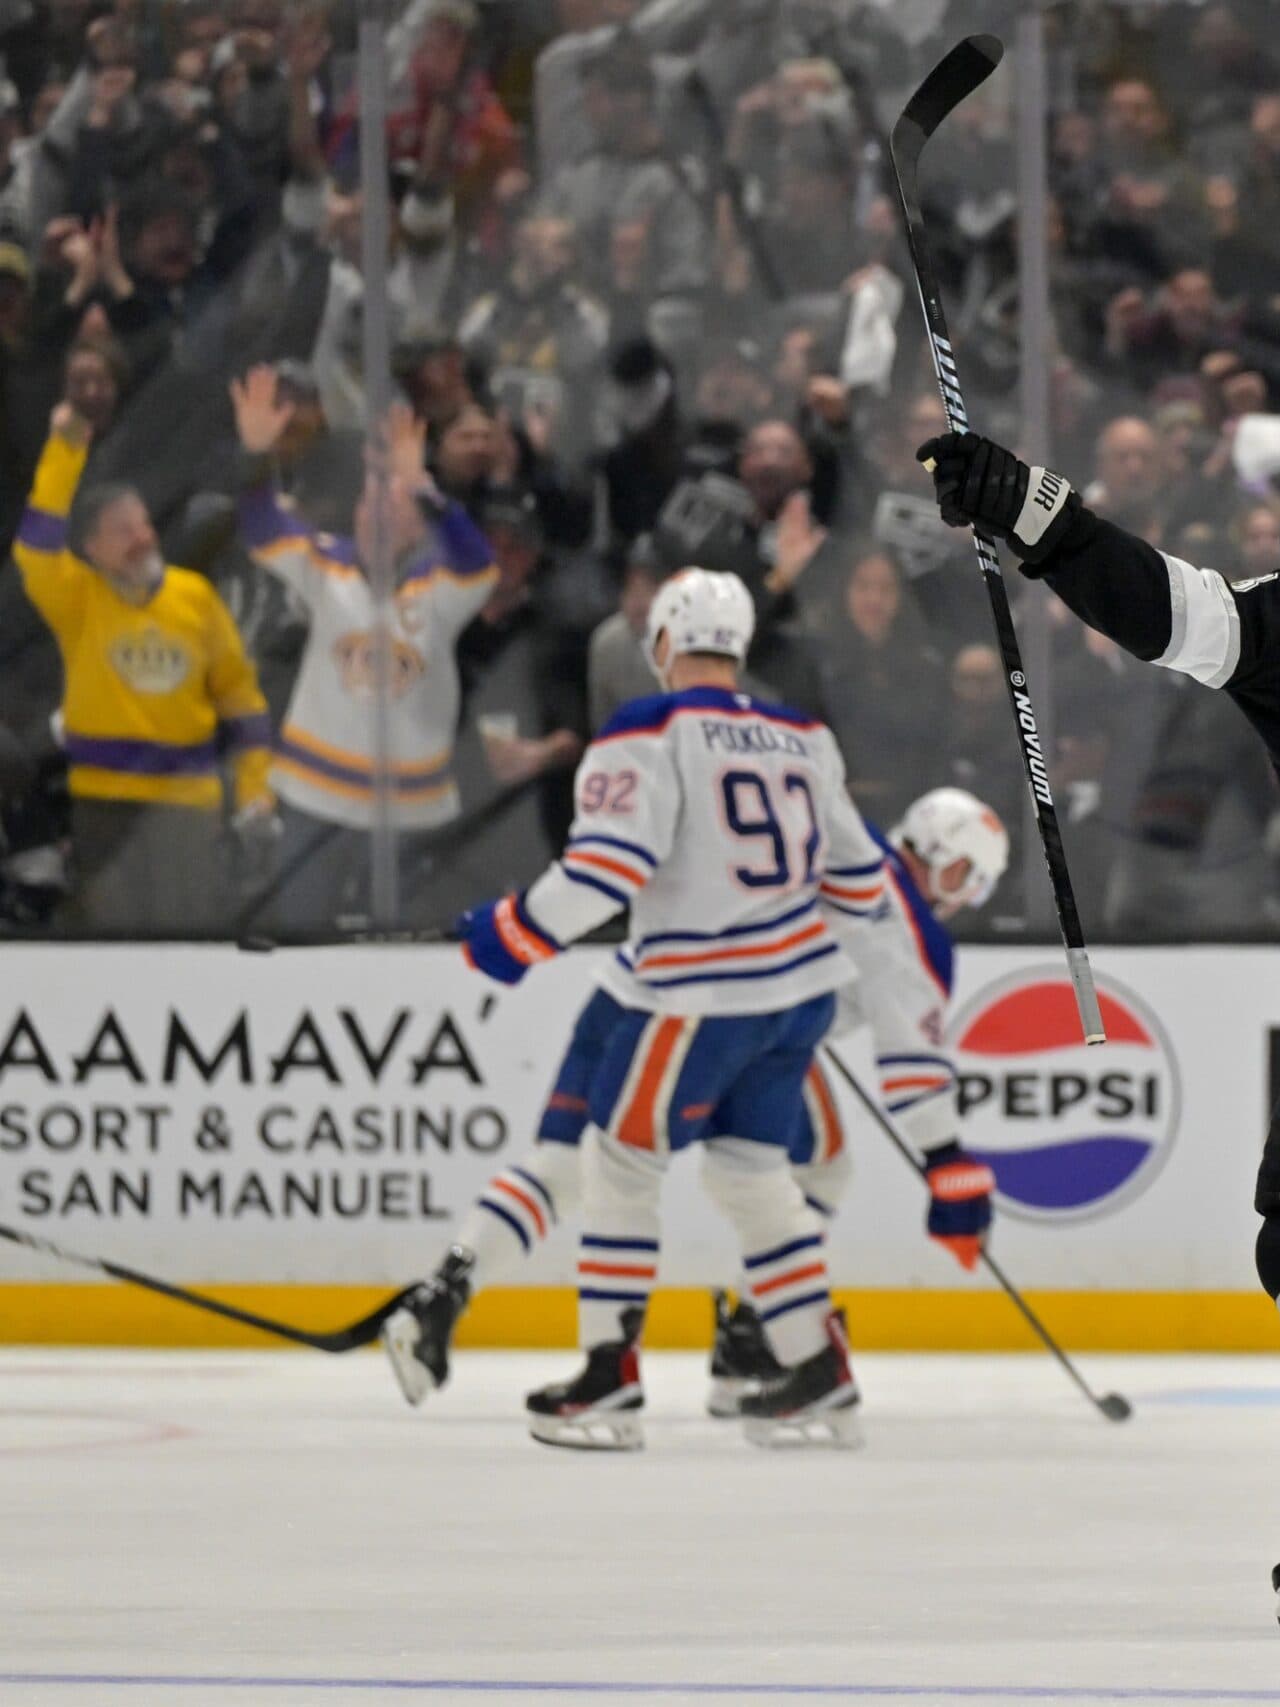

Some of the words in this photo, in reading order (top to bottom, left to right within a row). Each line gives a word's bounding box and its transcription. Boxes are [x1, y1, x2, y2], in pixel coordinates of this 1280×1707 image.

[1013, 690, 1054, 806] NOVIUM
[581, 769, 638, 815] 92
[954, 1072, 1158, 1119] PEPSI
[0, 1105, 171, 1153] SORT
[195, 1105, 231, 1153] &
[258, 1105, 508, 1154] CASINO
[20, 1168, 150, 1217] SAN
[179, 1169, 450, 1219] MANUEL
